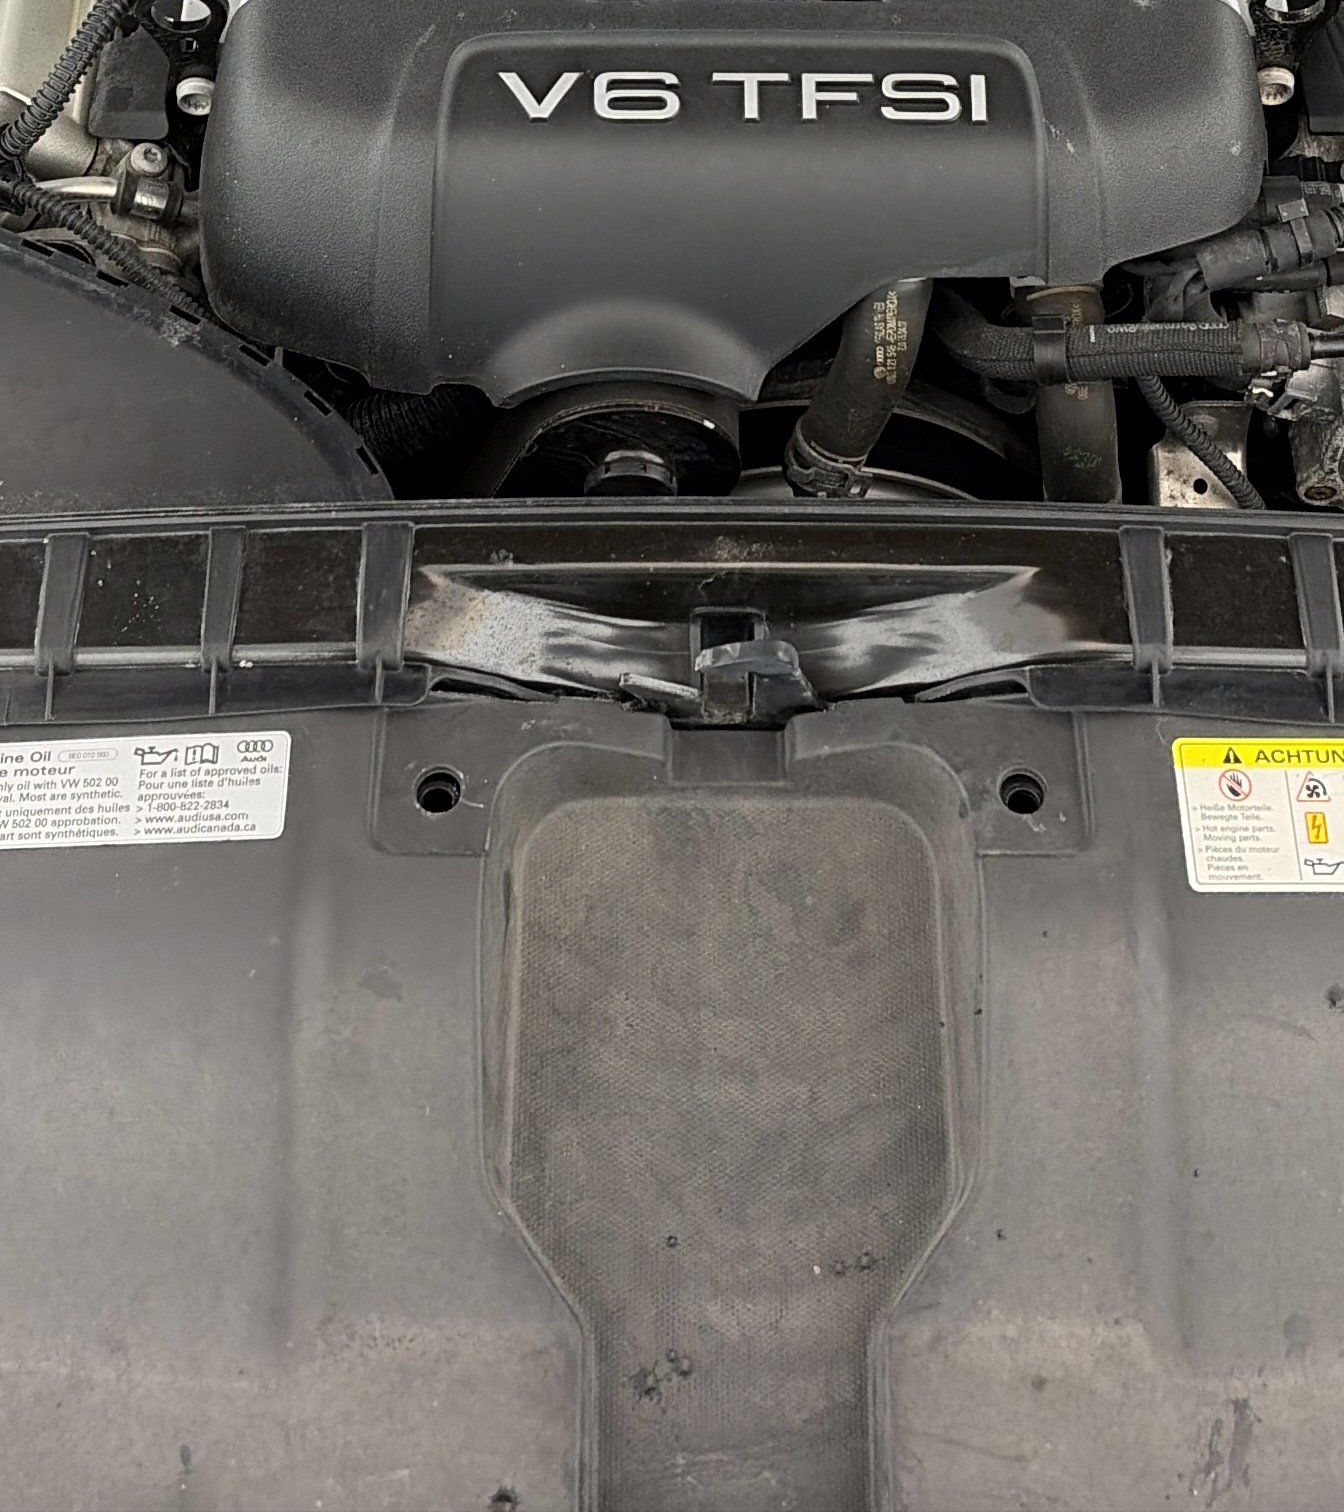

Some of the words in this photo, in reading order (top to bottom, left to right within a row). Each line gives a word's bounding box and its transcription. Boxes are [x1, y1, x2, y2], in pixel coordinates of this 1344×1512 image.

[497, 71, 682, 122] V6
[712, 72, 989, 123] TFSI
[30, 751, 52, 762] Oil
[14, 766, 76, 777] moteur
[140, 769, 158, 778] For
[171, 768, 186, 777] list
[190, 766, 201, 776] of
[204, 765, 256, 777] approved
[260, 764, 283, 774] oils:
[17, 781, 30, 790] oil
[33, 780, 56, 790] with
[61, 779, 80, 788] VW
[83, 778, 102, 787] 502
[105, 777, 119, 786] 00
[139, 780, 165, 789] Pour
[168, 780, 188, 788] une
[192, 778, 214, 788] liste
[217, 777, 261, 787] d'huiles
[19, 793, 47, 802] Most
[50, 793, 67, 801] are
[70, 789, 123, 801] synthetic.
[138, 789, 205, 803] approuvées:
[6, 806, 72, 818] uniquement
[75, 805, 94, 814] des
[97, 803, 131, 814] huiles
[147, 800, 230, 812] 1-800-822-2834
[12, 819, 31, 828] 502
[34, 818, 48, 827] 00
[51, 816, 121, 827] approbation.
[145, 812, 248, 823] www.audiusa.com
[1201, 813, 1238, 822] Bewegte
[18, 830, 41, 840] sont
[45, 828, 119, 840] synthétiques.
[144, 823, 256, 834] www.audicanada.ca
[1220, 826, 1249, 834] engine
[1203, 834, 1236, 843] Moving
